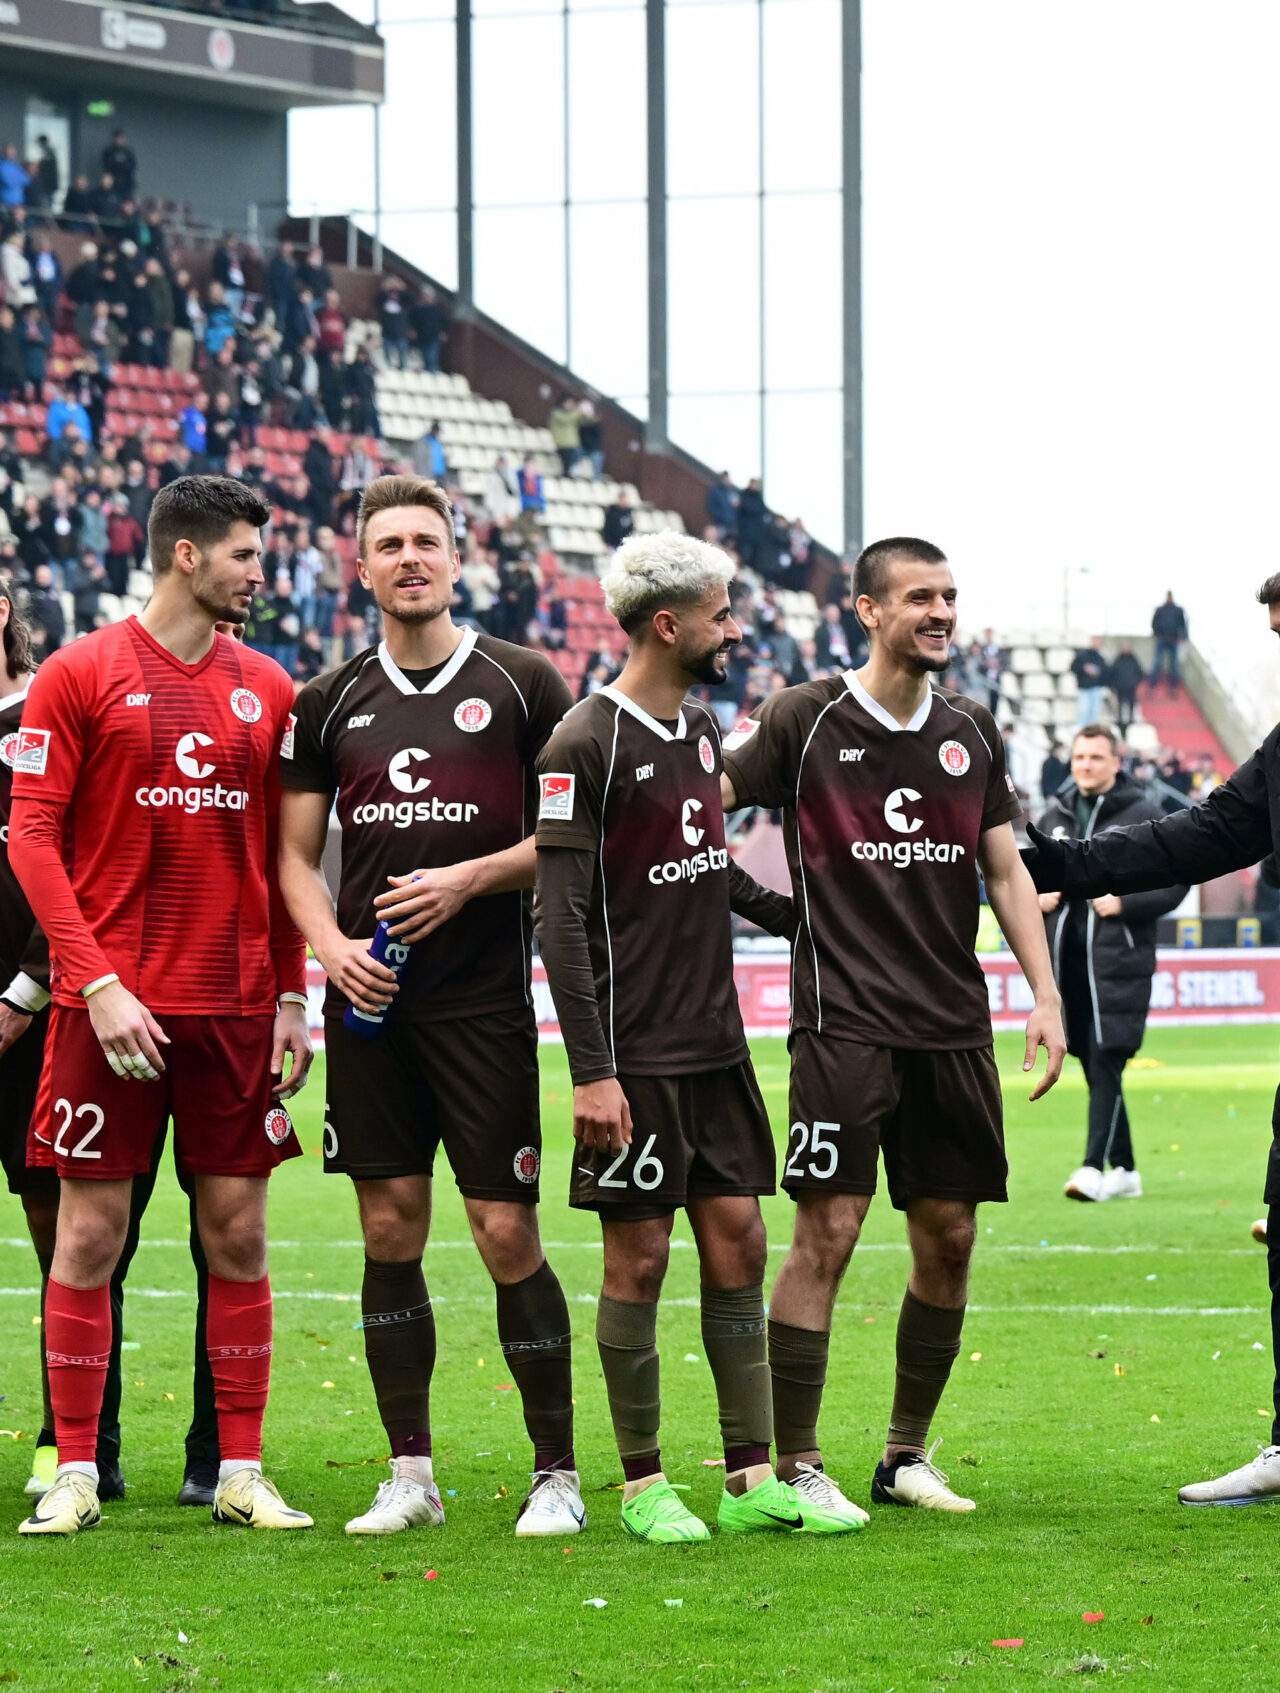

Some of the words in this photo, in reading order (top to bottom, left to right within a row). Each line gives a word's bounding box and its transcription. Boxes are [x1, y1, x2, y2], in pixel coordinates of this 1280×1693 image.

[135, 783, 250, 814] congstar
[352, 796, 480, 829] congstar
[648, 845, 728, 884] congsta
[851, 837, 965, 868] congstar
[53, 1097, 105, 1159] 22
[597, 1133, 665, 1191] 26
[785, 1121, 841, 1179] 25
